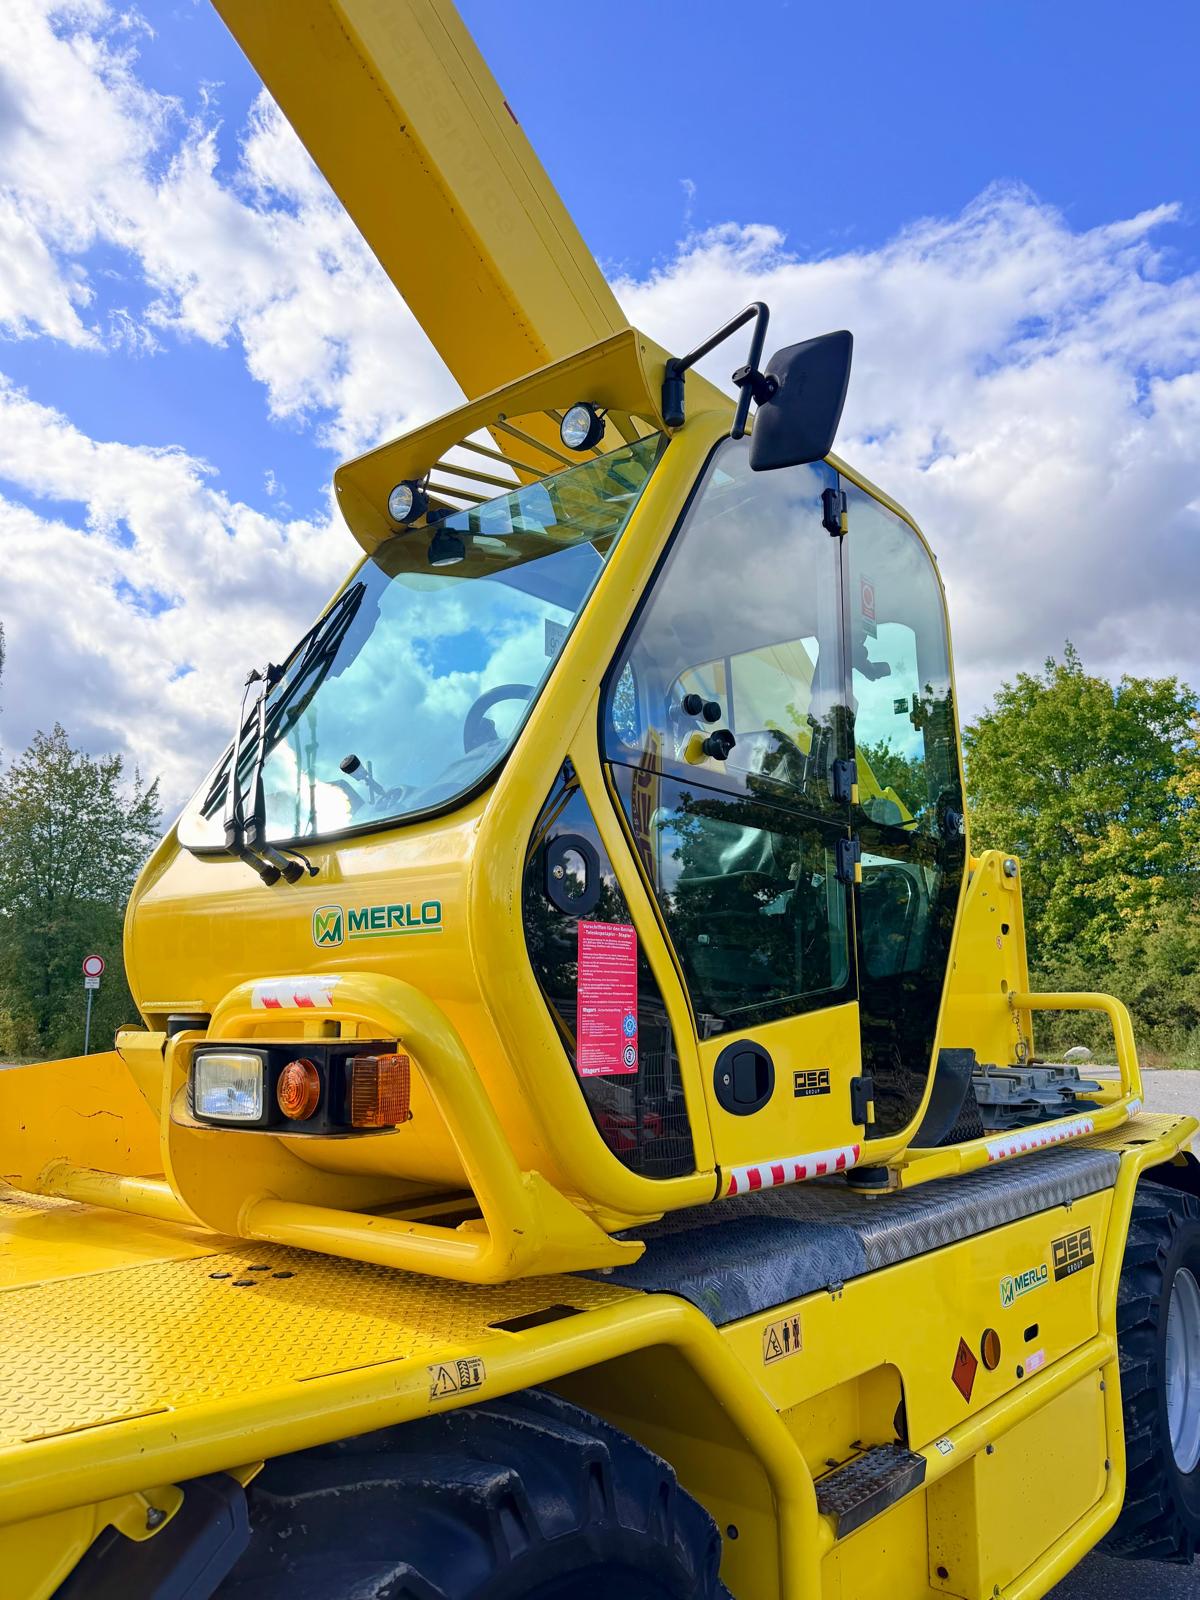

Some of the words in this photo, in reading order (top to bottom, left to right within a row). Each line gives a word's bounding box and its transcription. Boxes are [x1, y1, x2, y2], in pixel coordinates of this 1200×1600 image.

[348, 901, 441, 931] MERLO
[1015, 1264, 1048, 1291] MERLO
[1067, 1260, 1083, 1274] GROUP
